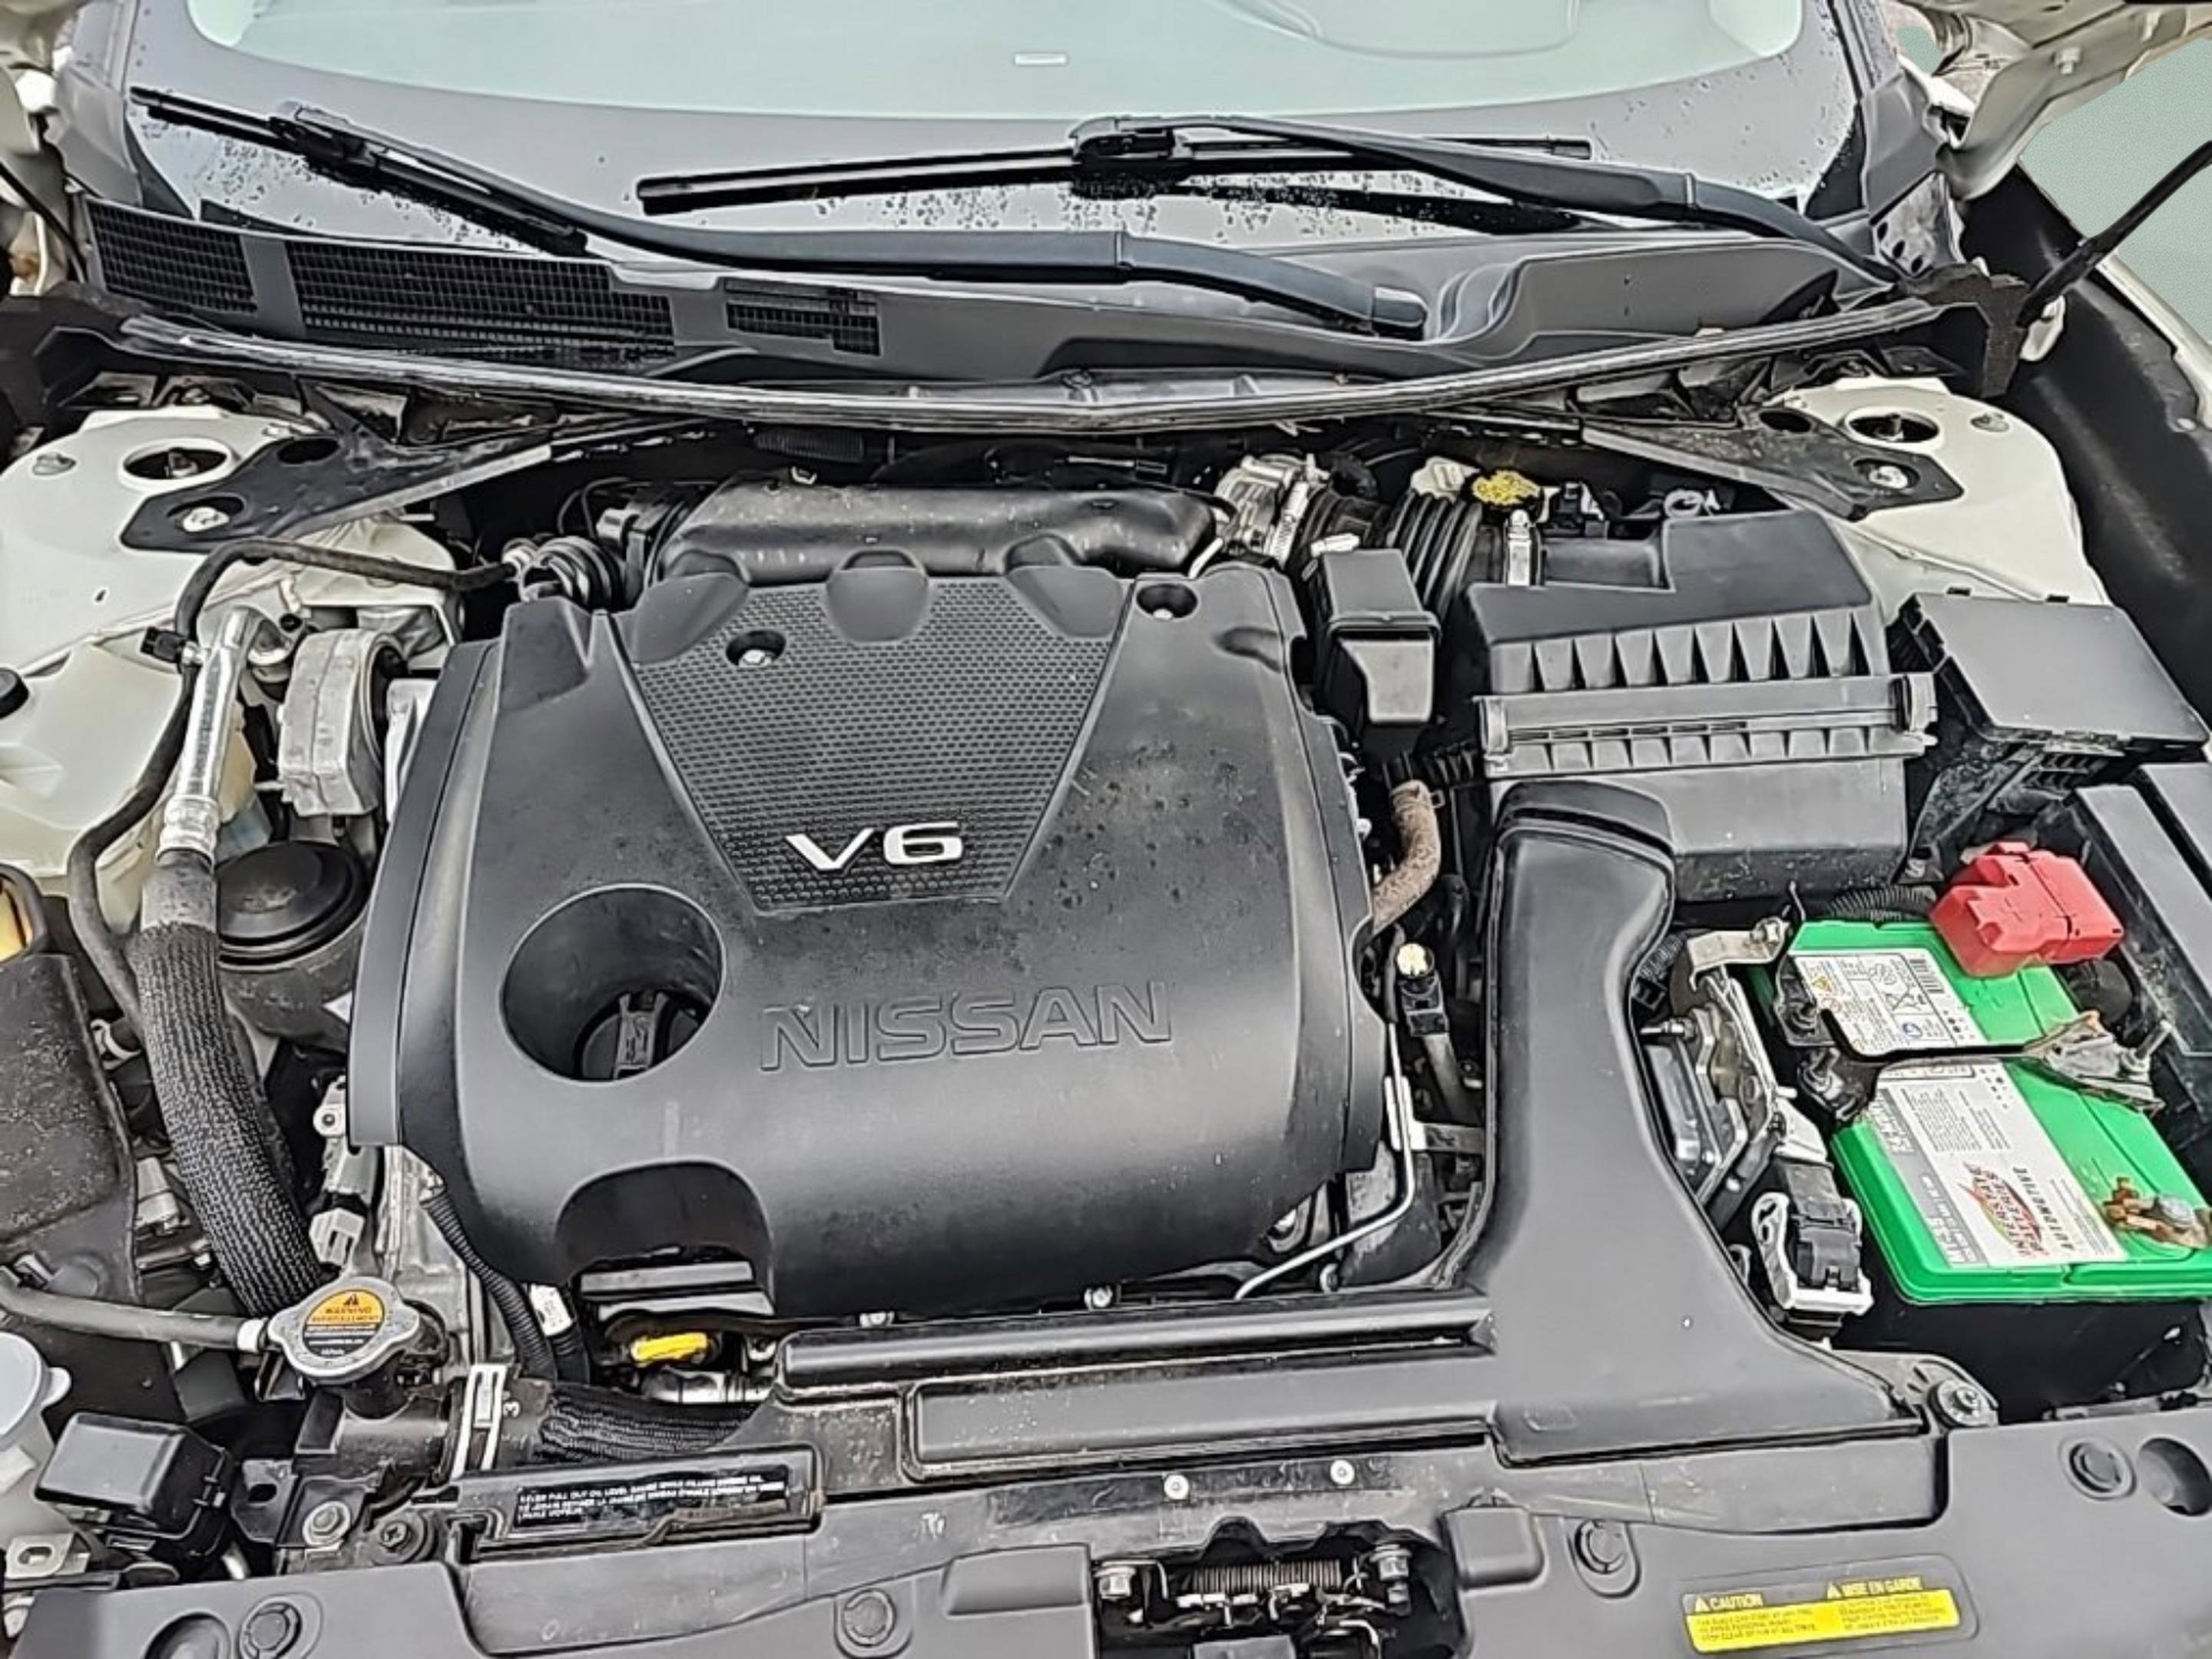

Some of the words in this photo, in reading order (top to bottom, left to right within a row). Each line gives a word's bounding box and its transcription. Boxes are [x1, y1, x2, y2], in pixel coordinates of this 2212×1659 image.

[785, 821, 964, 871] V6
[760, 981, 1172, 1071] NISSAN
[2011, 1164, 2078, 1250] AUTOMOTIVE
[1710, 1594, 1763, 1611] CAUTION
